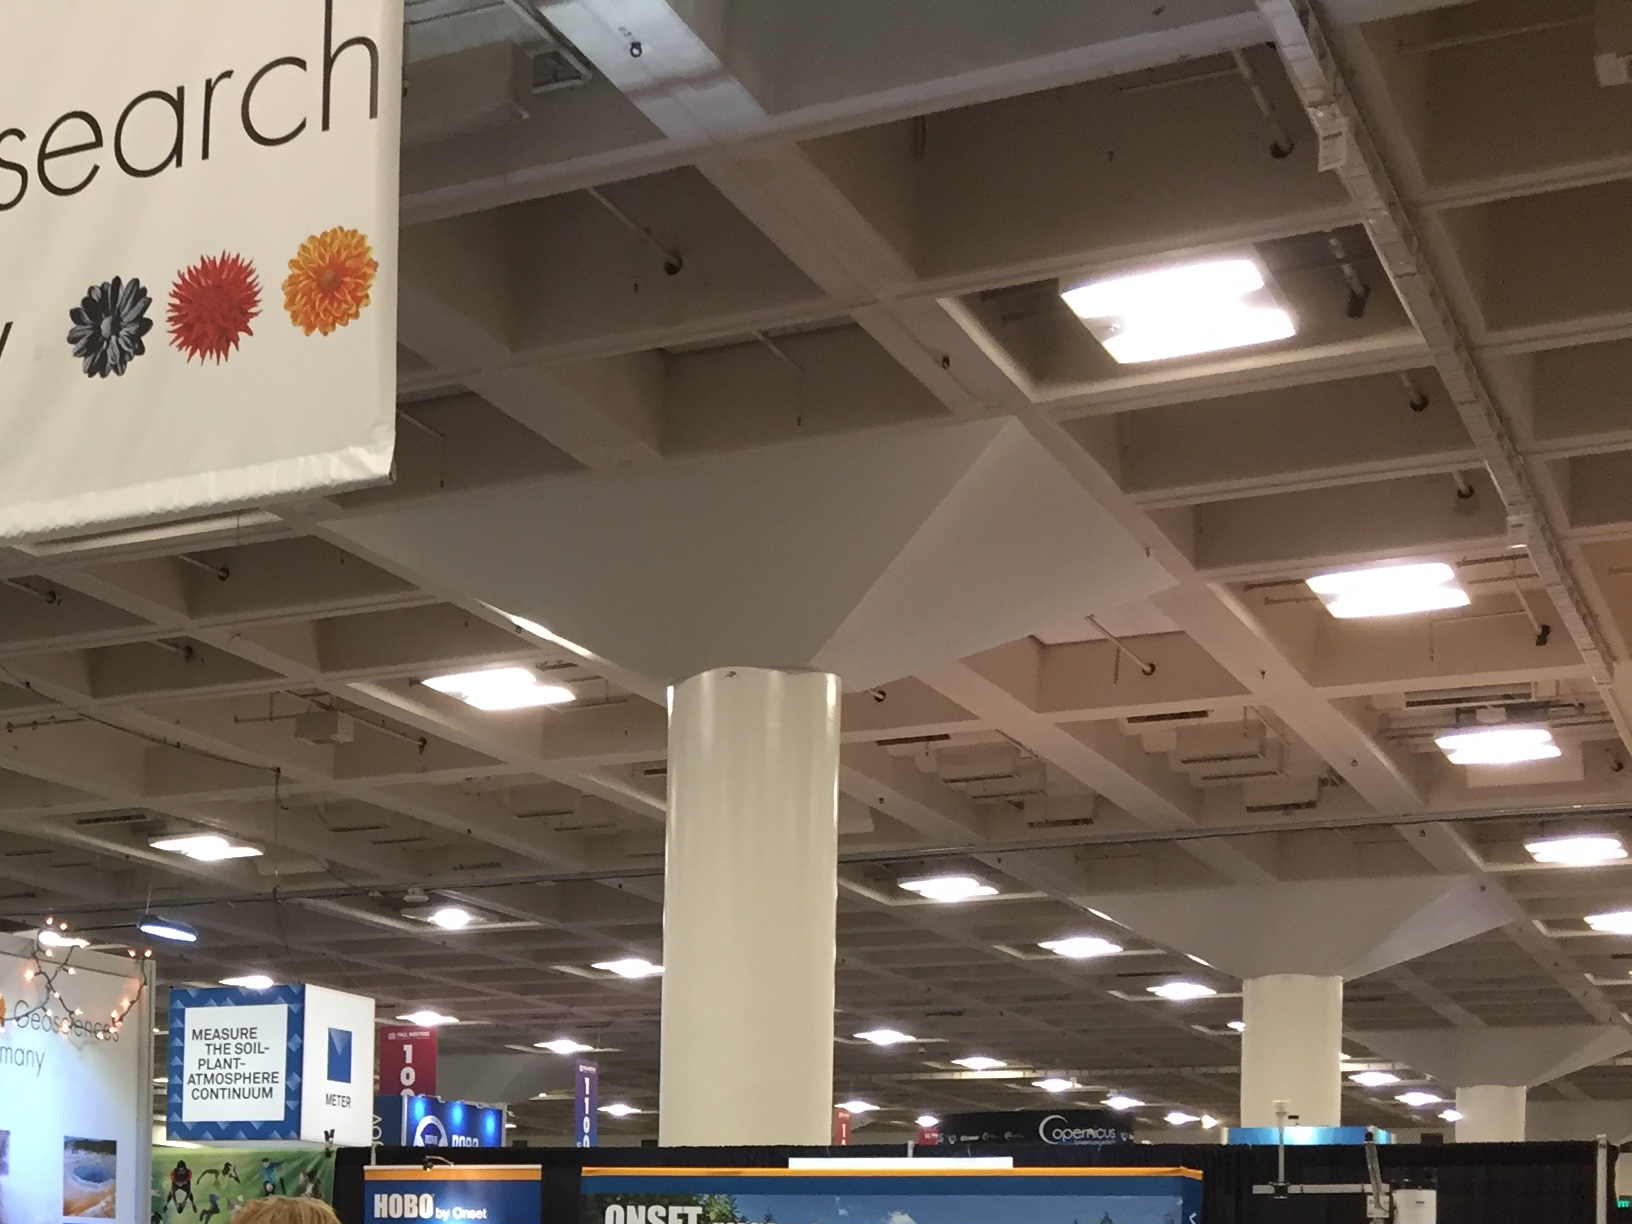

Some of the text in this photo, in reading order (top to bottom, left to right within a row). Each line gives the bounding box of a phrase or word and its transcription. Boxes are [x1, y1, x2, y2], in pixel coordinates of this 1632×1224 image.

[191, 1027, 258, 1041] MEASURE
[205, 1042, 270, 1055] THE SOIL-
[197, 1058, 246, 1070] PLANT-
[187, 1071, 280, 1085] ATMOSPHERE
[191, 1086, 274, 1100] CONTINUUM
[325, 1093, 352, 1109] METER
[1039, 1114, 1117, 1146] Copernicus
[373, 1193, 488, 1220] HOBO by Onset
